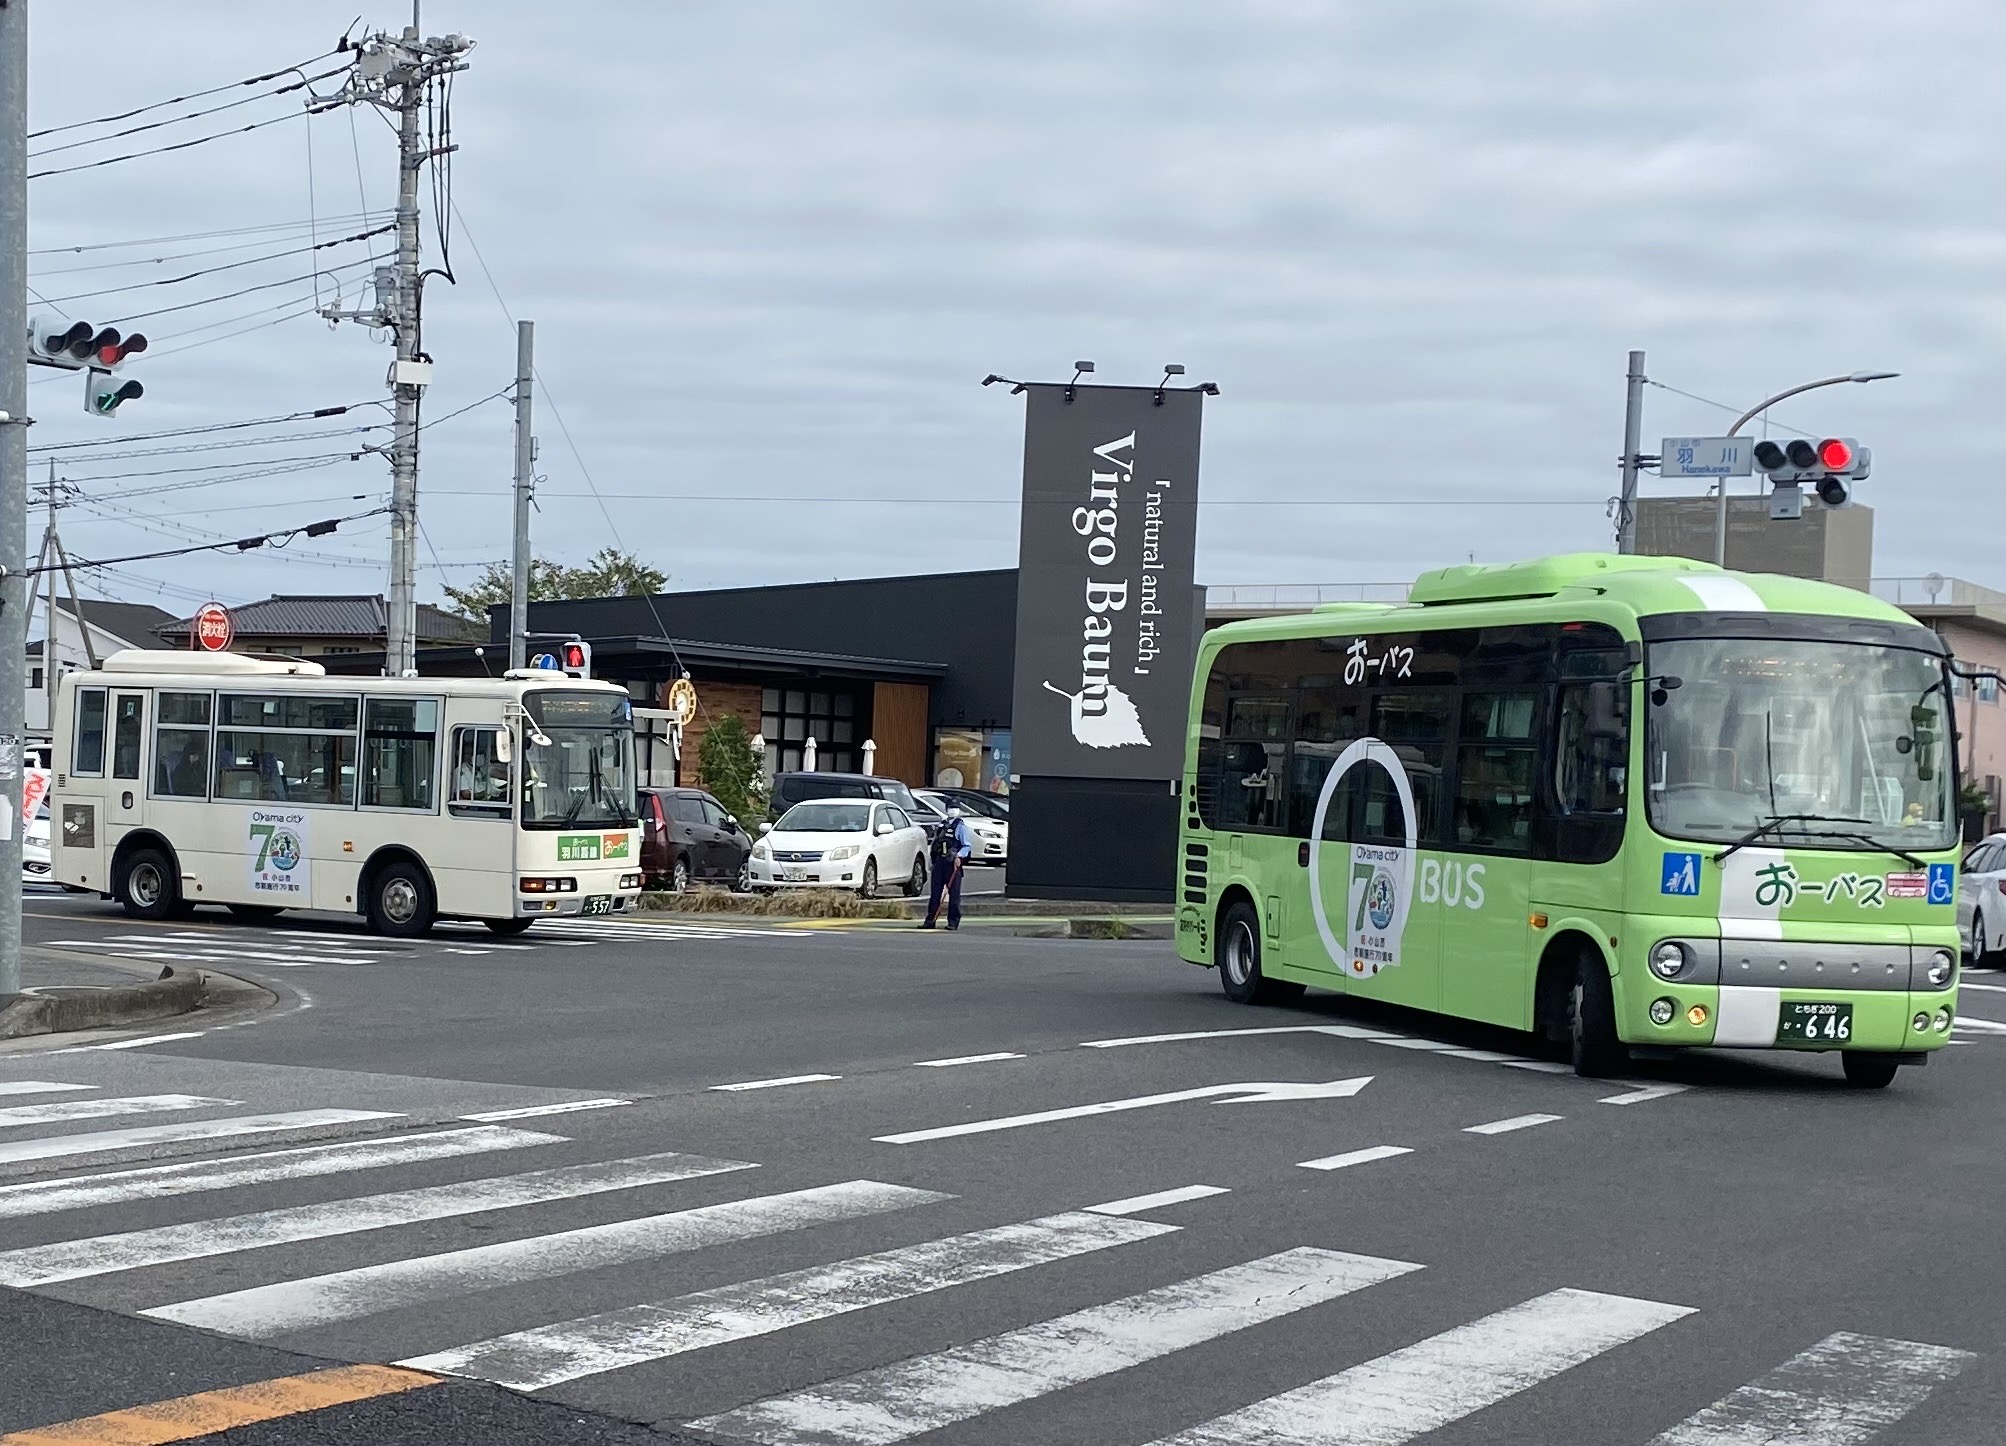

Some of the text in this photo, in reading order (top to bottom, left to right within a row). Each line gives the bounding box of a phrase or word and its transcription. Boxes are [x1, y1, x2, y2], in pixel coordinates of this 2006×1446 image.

[1072, 430, 1136, 720] Virgo Baum
[1140, 575, 1164, 615] and
[202, 621, 227, 639] 消火栓
[1344, 637, 1415, 686] おーバス
[252, 811, 305, 825] Oyama city
[1356, 846, 1401, 862] Oyama city
[1420, 858, 1486, 910] BUS
[1755, 862, 1884, 907] おーバス
